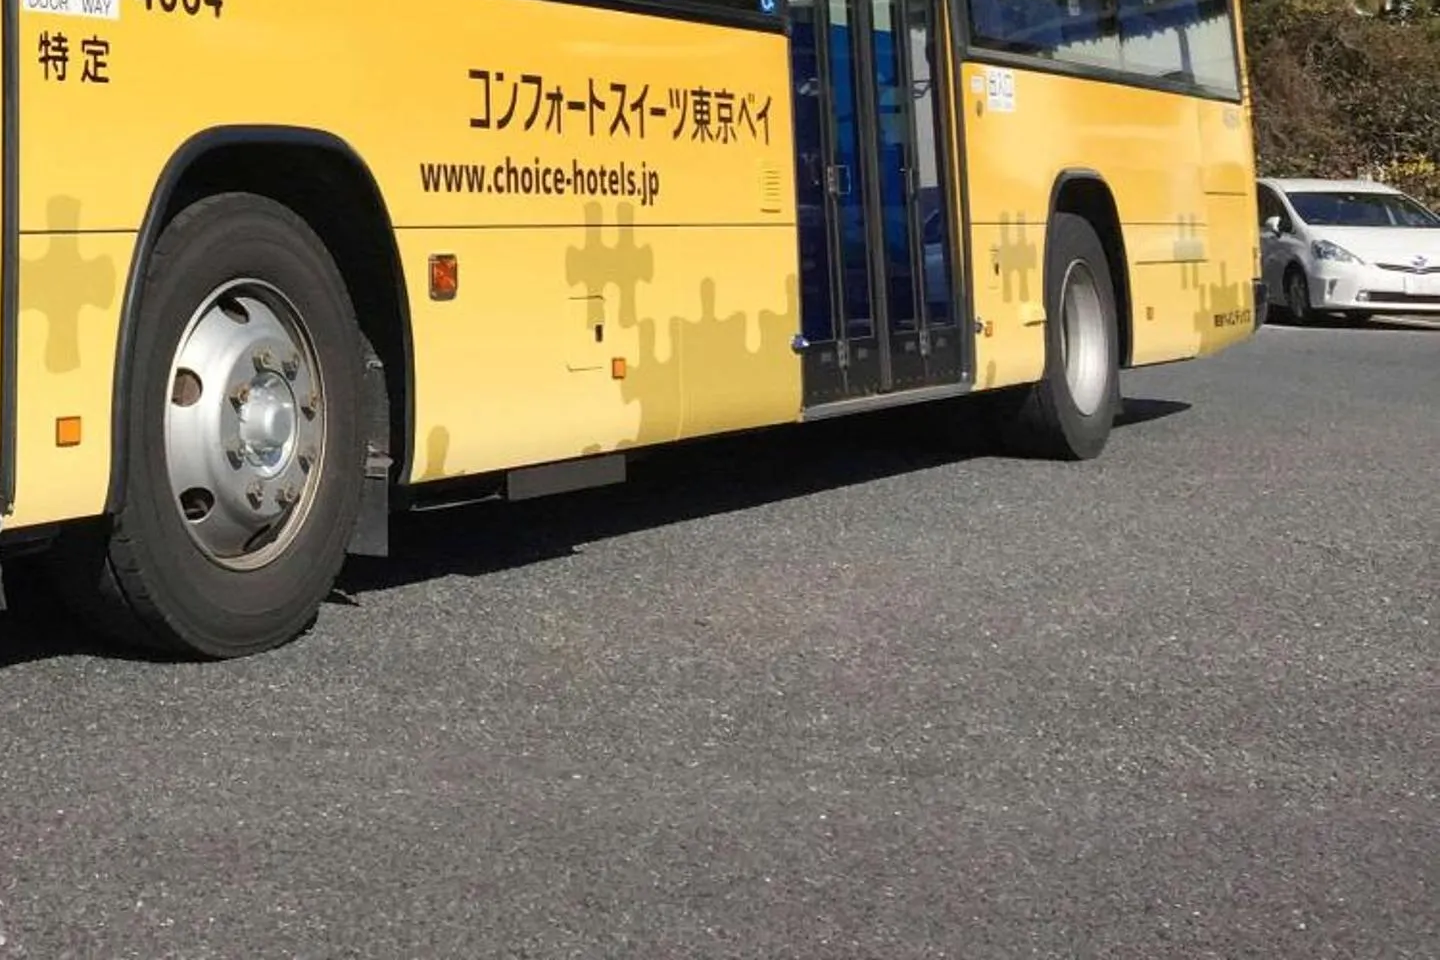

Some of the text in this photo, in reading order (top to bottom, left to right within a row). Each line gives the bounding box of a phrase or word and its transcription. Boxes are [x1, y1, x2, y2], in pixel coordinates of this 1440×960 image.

[38, 30, 110, 84] 特定
[468, 69, 772, 146] コンフォートスイーツ東京ベイ
[420, 156, 660, 206] www.choice-hotels.jp
